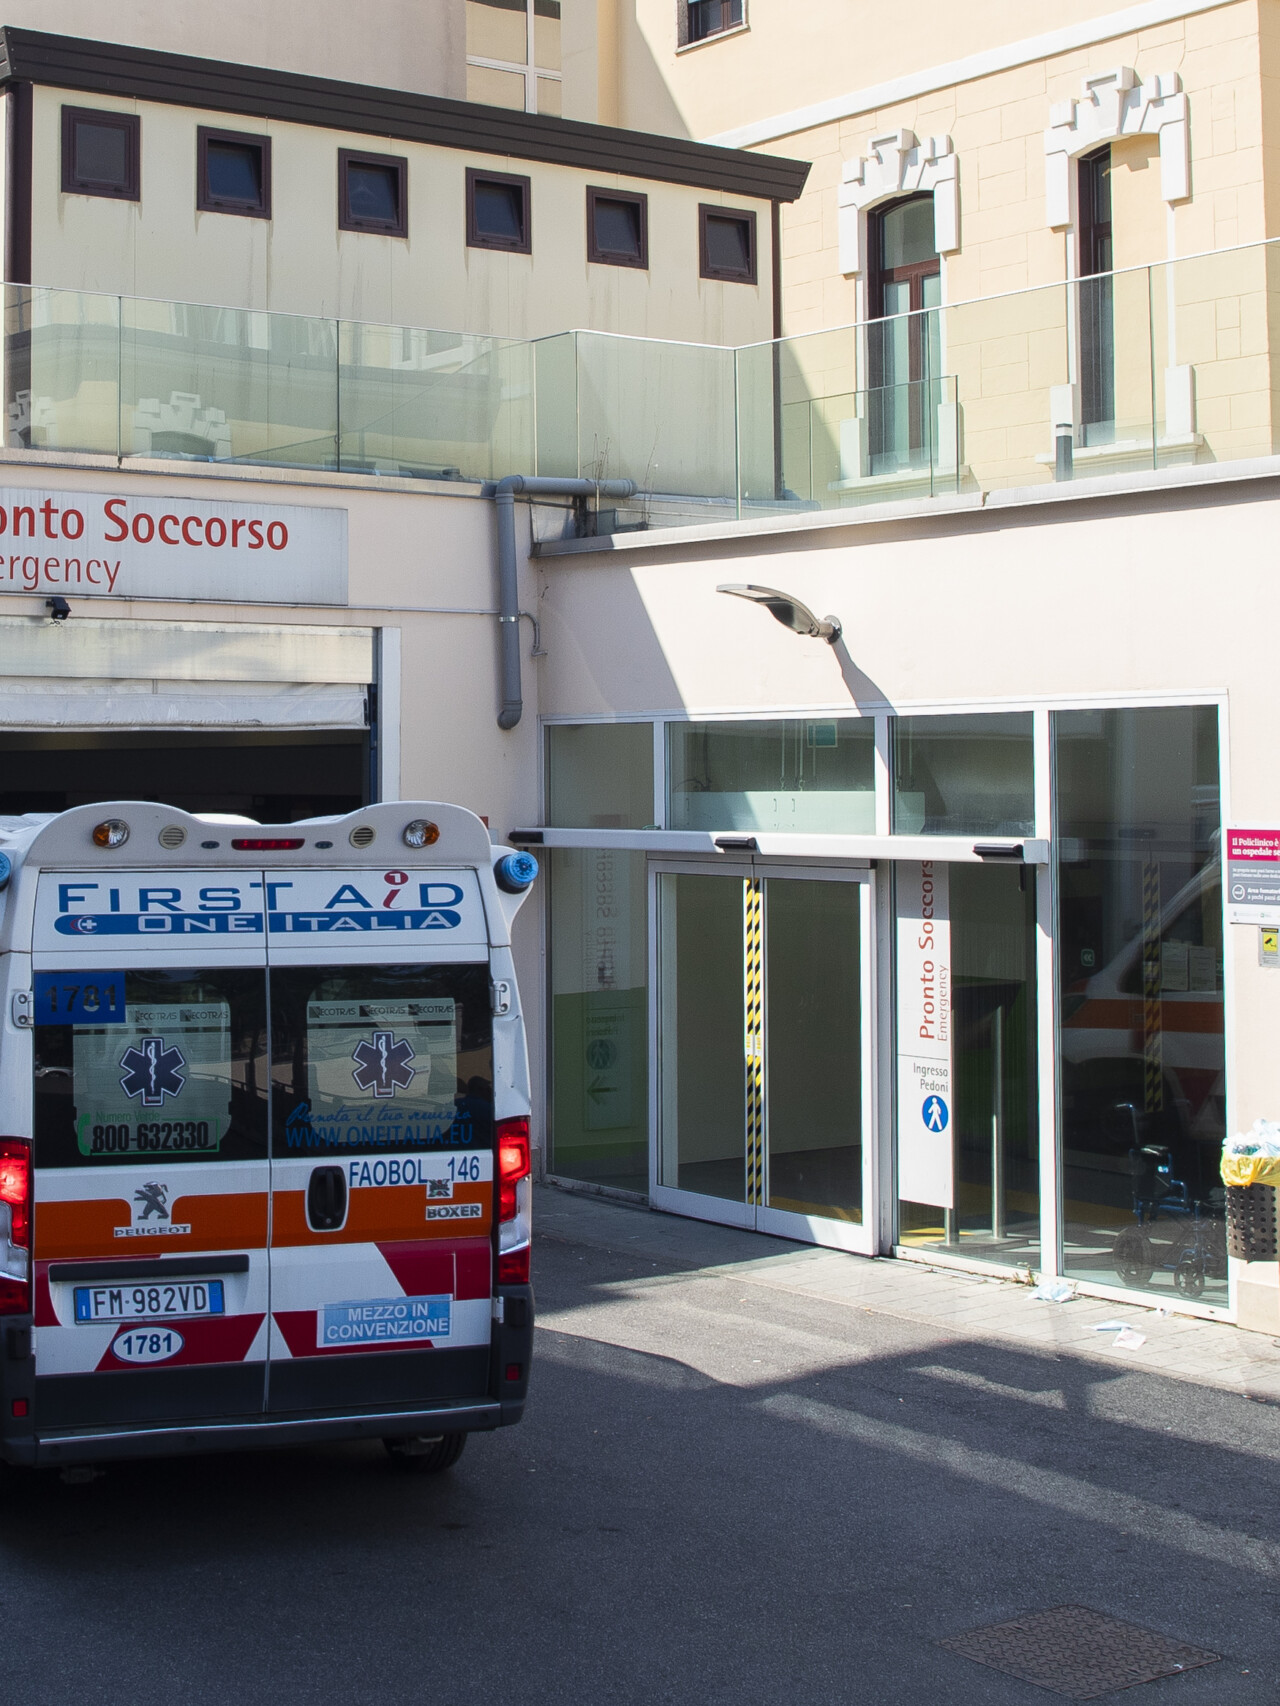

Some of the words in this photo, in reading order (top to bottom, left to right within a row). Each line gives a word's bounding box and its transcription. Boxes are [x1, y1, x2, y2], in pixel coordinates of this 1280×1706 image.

[103, 498, 290, 551] Soccorso
[1238, 837, 1273, 847] Policlinico
[1242, 847, 1272, 858] ospedale
[58, 882, 293, 913] FIRST
[919, 860, 934, 950] Soccors
[138, 914, 257, 933] ONE
[285, 912, 454, 932] ITALIA
[44, 984, 117, 1012] 1781
[920, 960, 935, 1040] Pronto
[937, 964, 948, 1042] Emergency
[320, 1008, 356, 1016] ECOTRAS
[913, 1062, 948, 1078] Ingresso
[920, 1078, 948, 1092] Pedoni
[95, 1112, 132, 1123] Numero
[134, 1110, 160, 1122] Verde
[376, 1104, 404, 1121] tuo
[92, 1121, 209, 1152] 800-632330
[286, 1123, 474, 1148] WWW.ONEITALIA.EU
[349, 1158, 428, 1187] FAOBOL
[447, 1156, 480, 1182] 146
[426, 1205, 480, 1219] BOXER
[114, 1226, 190, 1236] PEUGEOT
[348, 1305, 408, 1322] MEZZO
[412, 1302, 429, 1318] IN
[326, 1318, 449, 1340] CONVENZIONE
[122, 1333, 172, 1355] 1781
